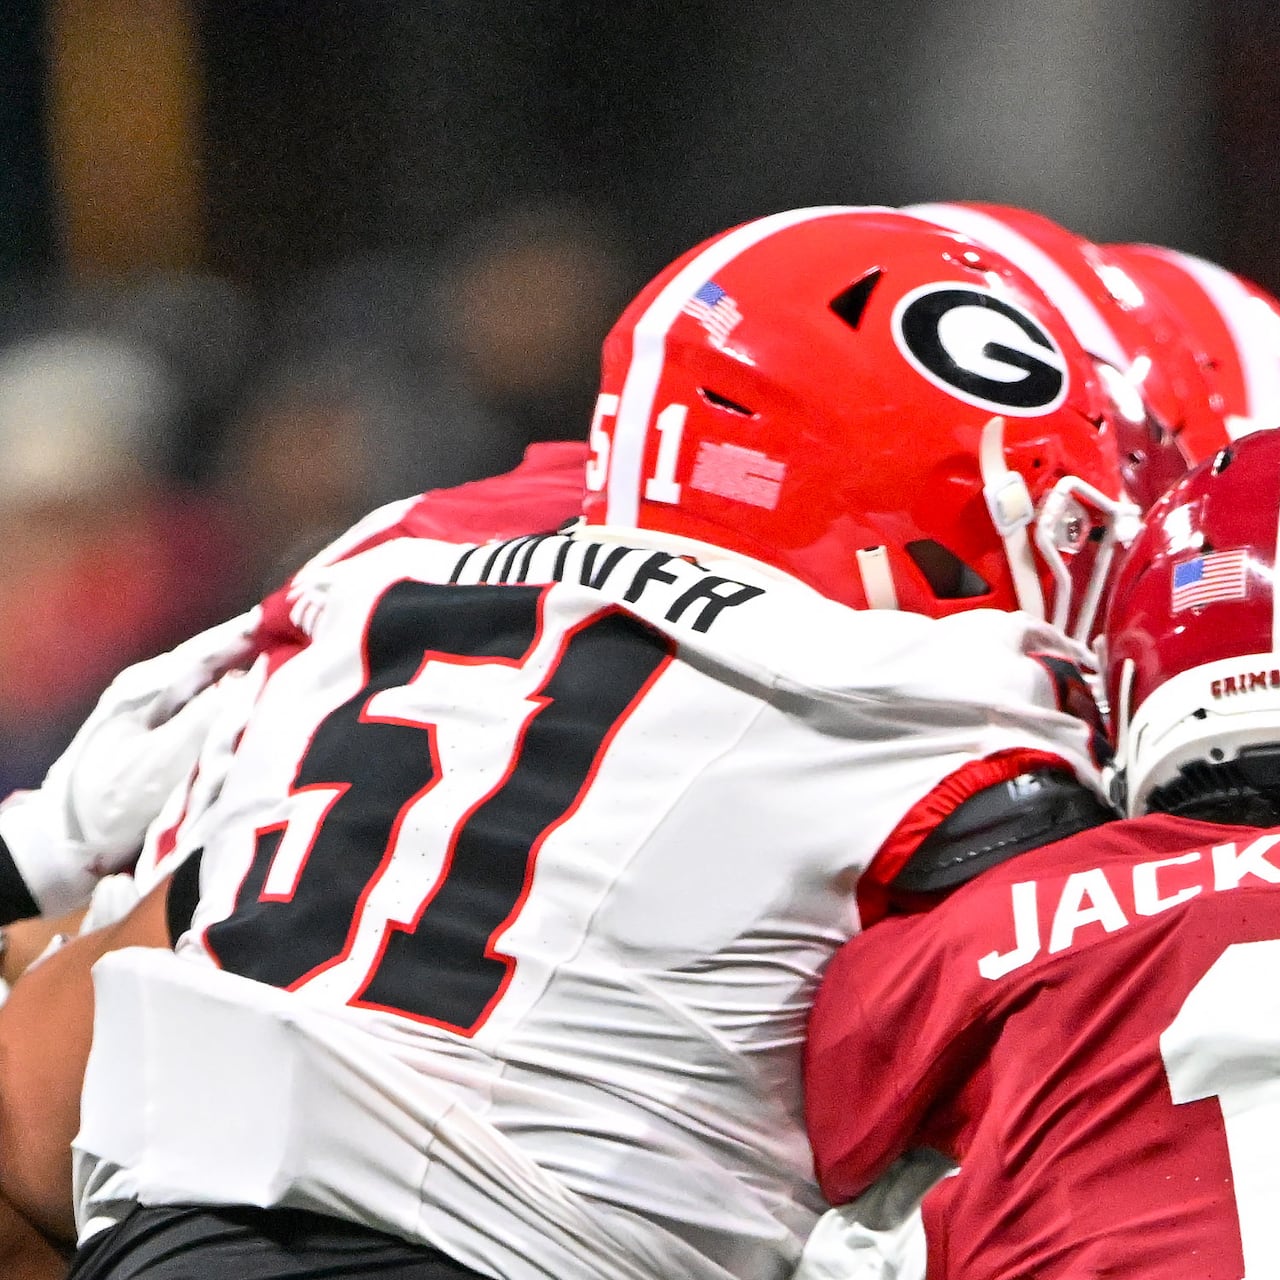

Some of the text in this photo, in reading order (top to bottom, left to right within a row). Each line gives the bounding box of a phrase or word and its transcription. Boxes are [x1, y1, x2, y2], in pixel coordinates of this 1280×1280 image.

[901, 289, 1064, 409] G
[585, 393, 689, 505] 51
[202, 576, 677, 1037] 51
